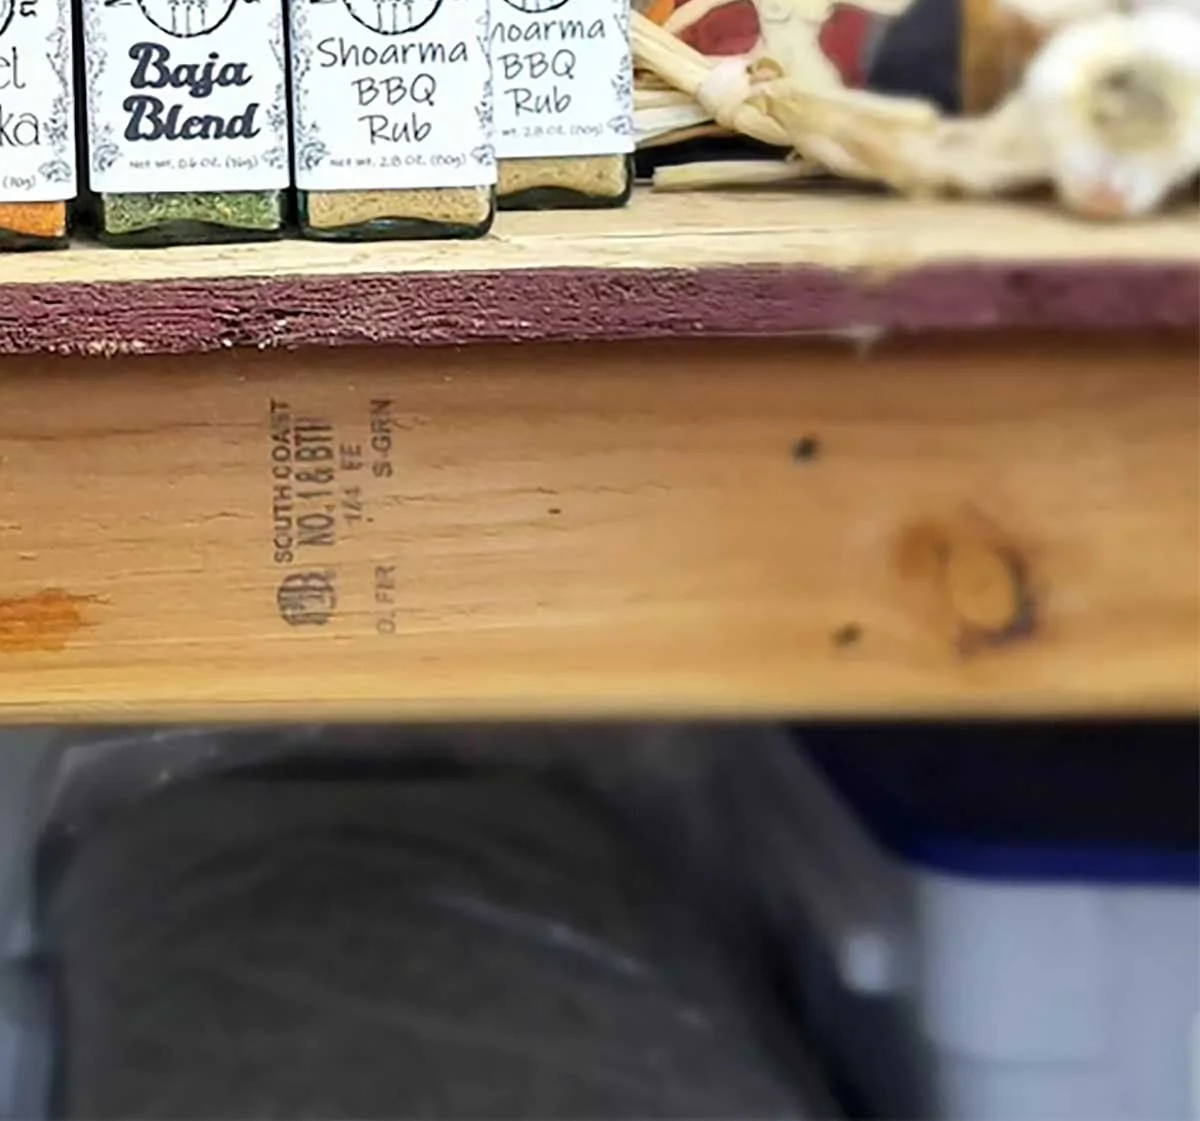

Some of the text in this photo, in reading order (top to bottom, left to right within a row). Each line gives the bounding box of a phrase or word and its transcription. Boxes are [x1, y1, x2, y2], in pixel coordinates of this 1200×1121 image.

[490, 18, 606, 44] oarma
[316, 37, 468, 68] Shoarma
[498, 49, 576, 80] BBQ
[128, 41, 253, 98] Baja
[351, 73, 436, 107] BBQ
[504, 85, 571, 116] Rub
[122, 94, 261, 142] Blend
[358, 112, 432, 144] Rub
[294, 467, 335, 484] &
[273, 485, 294, 564] SOUTH
[296, 505, 336, 547] NO.
